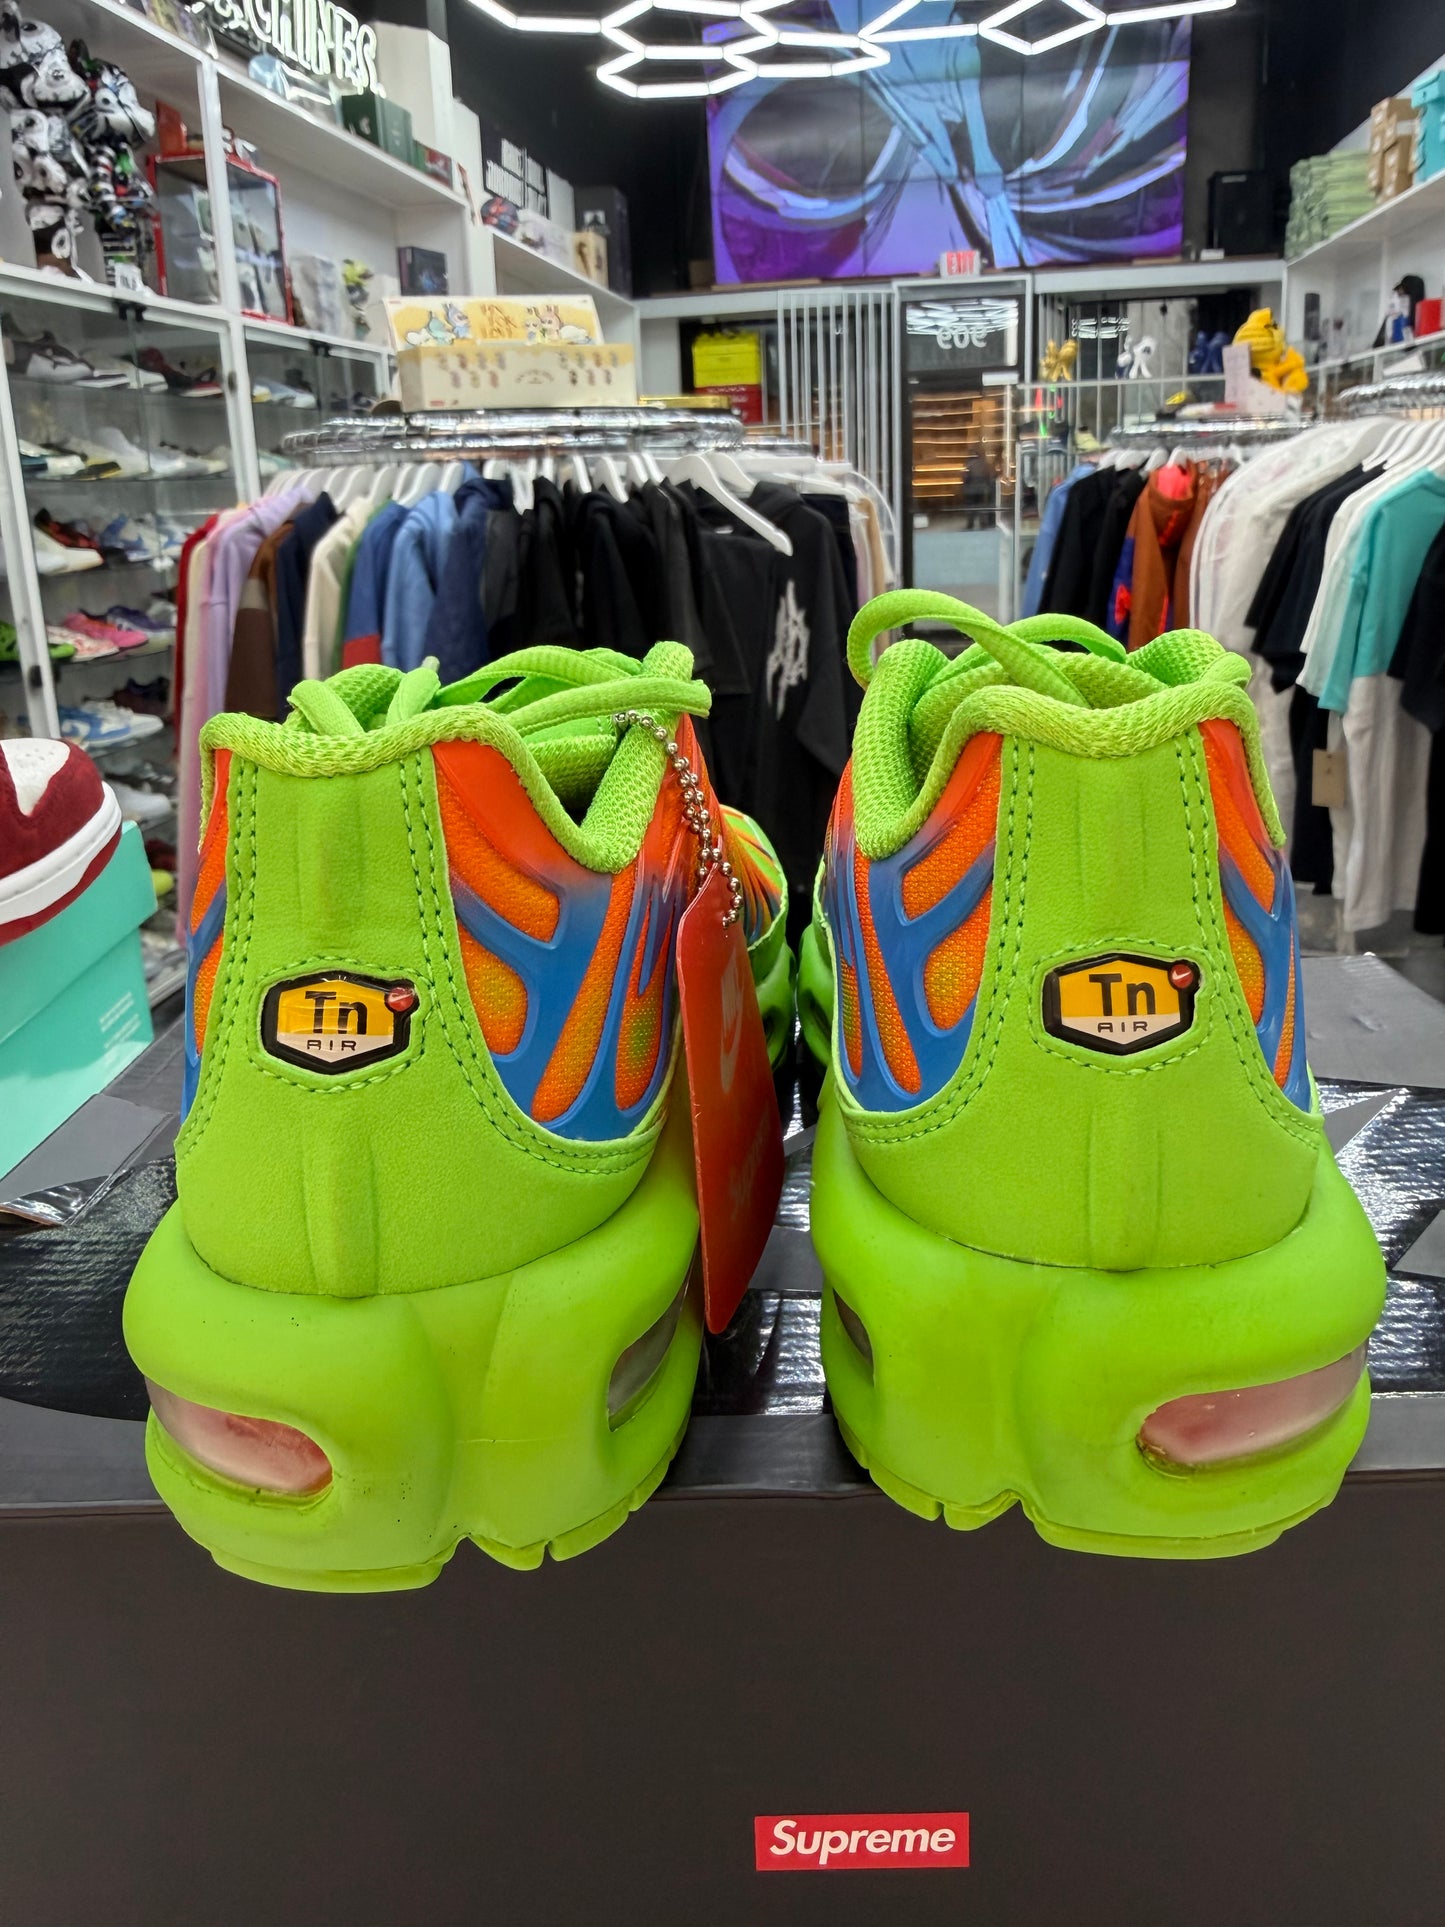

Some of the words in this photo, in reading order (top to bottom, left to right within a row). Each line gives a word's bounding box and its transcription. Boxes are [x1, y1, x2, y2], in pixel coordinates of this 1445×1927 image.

[946, 250, 976, 275] EXIT
[1088, 972, 1156, 1017] Tn
[304, 990, 368, 1035] Tn
[1097, 1020, 1149, 1033] AIR
[306, 1039, 357, 1051] AIR
[769, 1819, 956, 1865] Supreme
